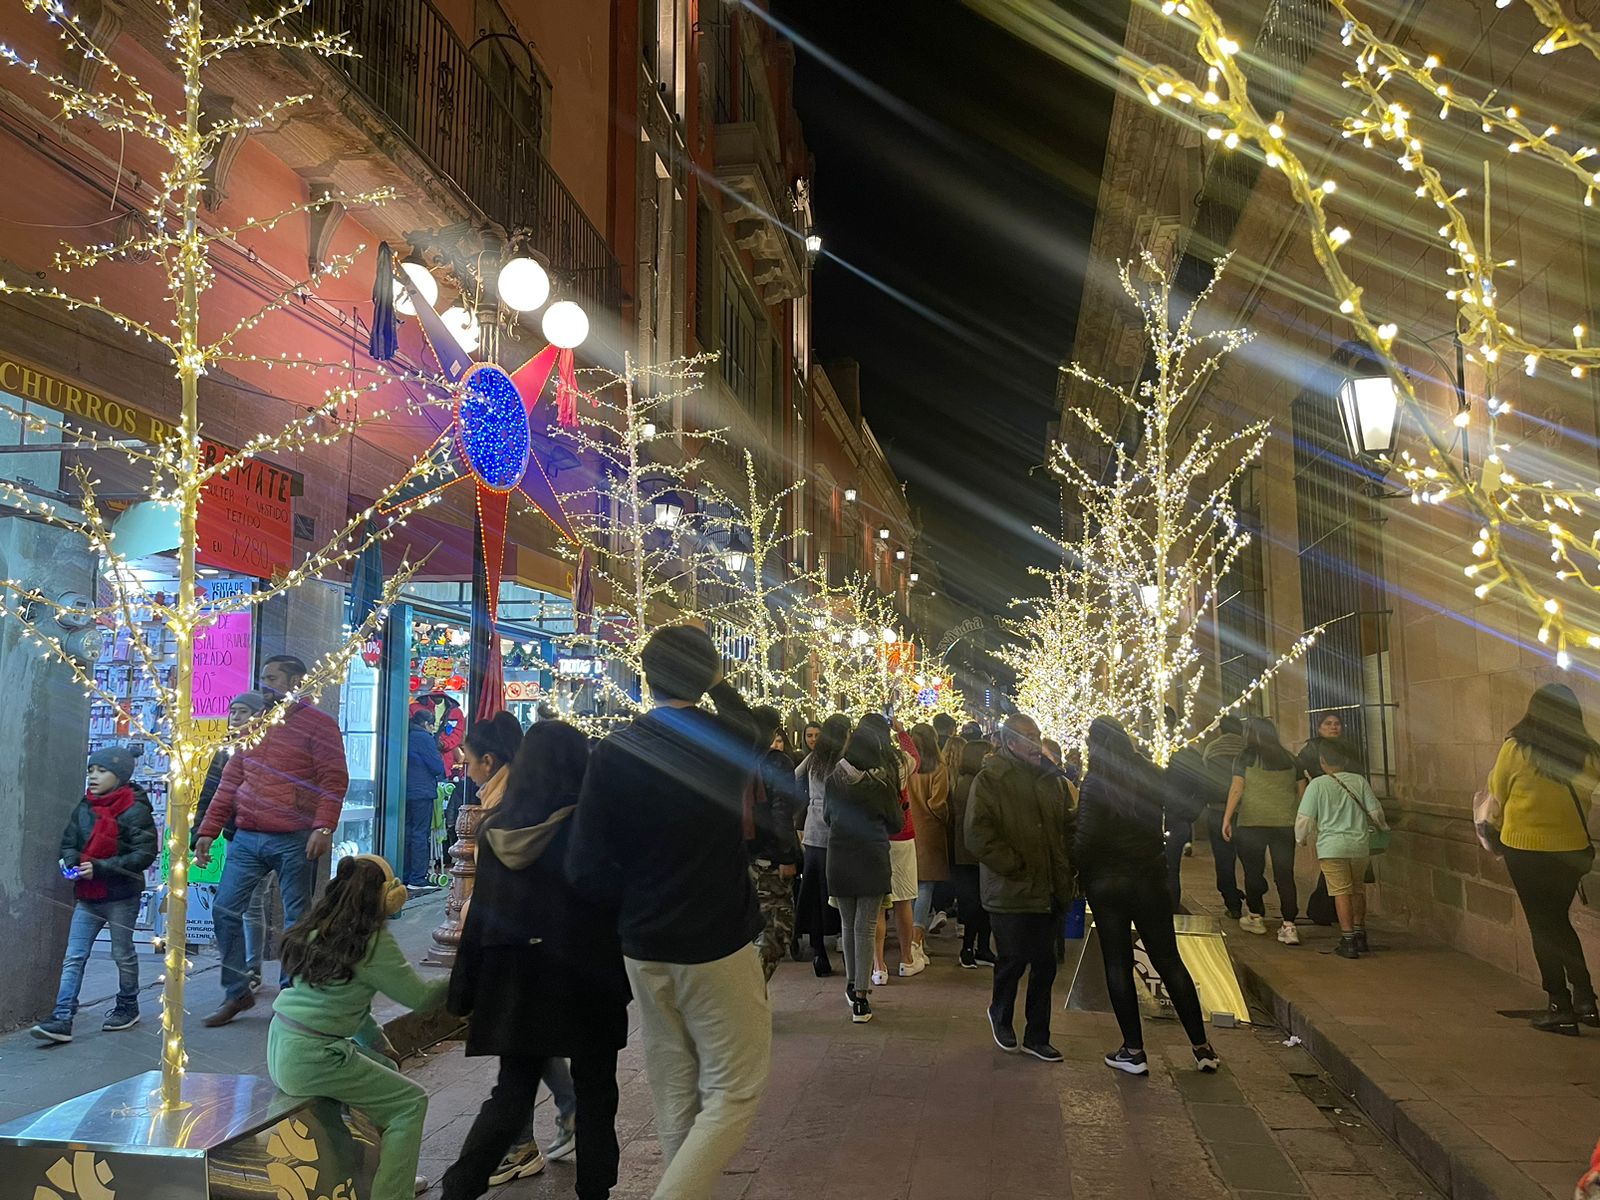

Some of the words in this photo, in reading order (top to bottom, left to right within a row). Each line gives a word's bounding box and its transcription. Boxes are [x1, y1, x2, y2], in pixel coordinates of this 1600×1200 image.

[0, 361, 137, 434] CHURROS
[203, 444, 289, 503] REMATE
[225, 507, 261, 529] TEJIDO
[244, 495, 250, 507] Y
[256, 502, 289, 523] VESTIDO
[212, 540, 223, 553] EN
[232, 528, 269, 570] $280
[211, 581, 233, 591] VENTA
[234, 581, 244, 591] DE
[193, 650, 232, 667] MPLADO
[191, 695, 237, 714] IVACID
